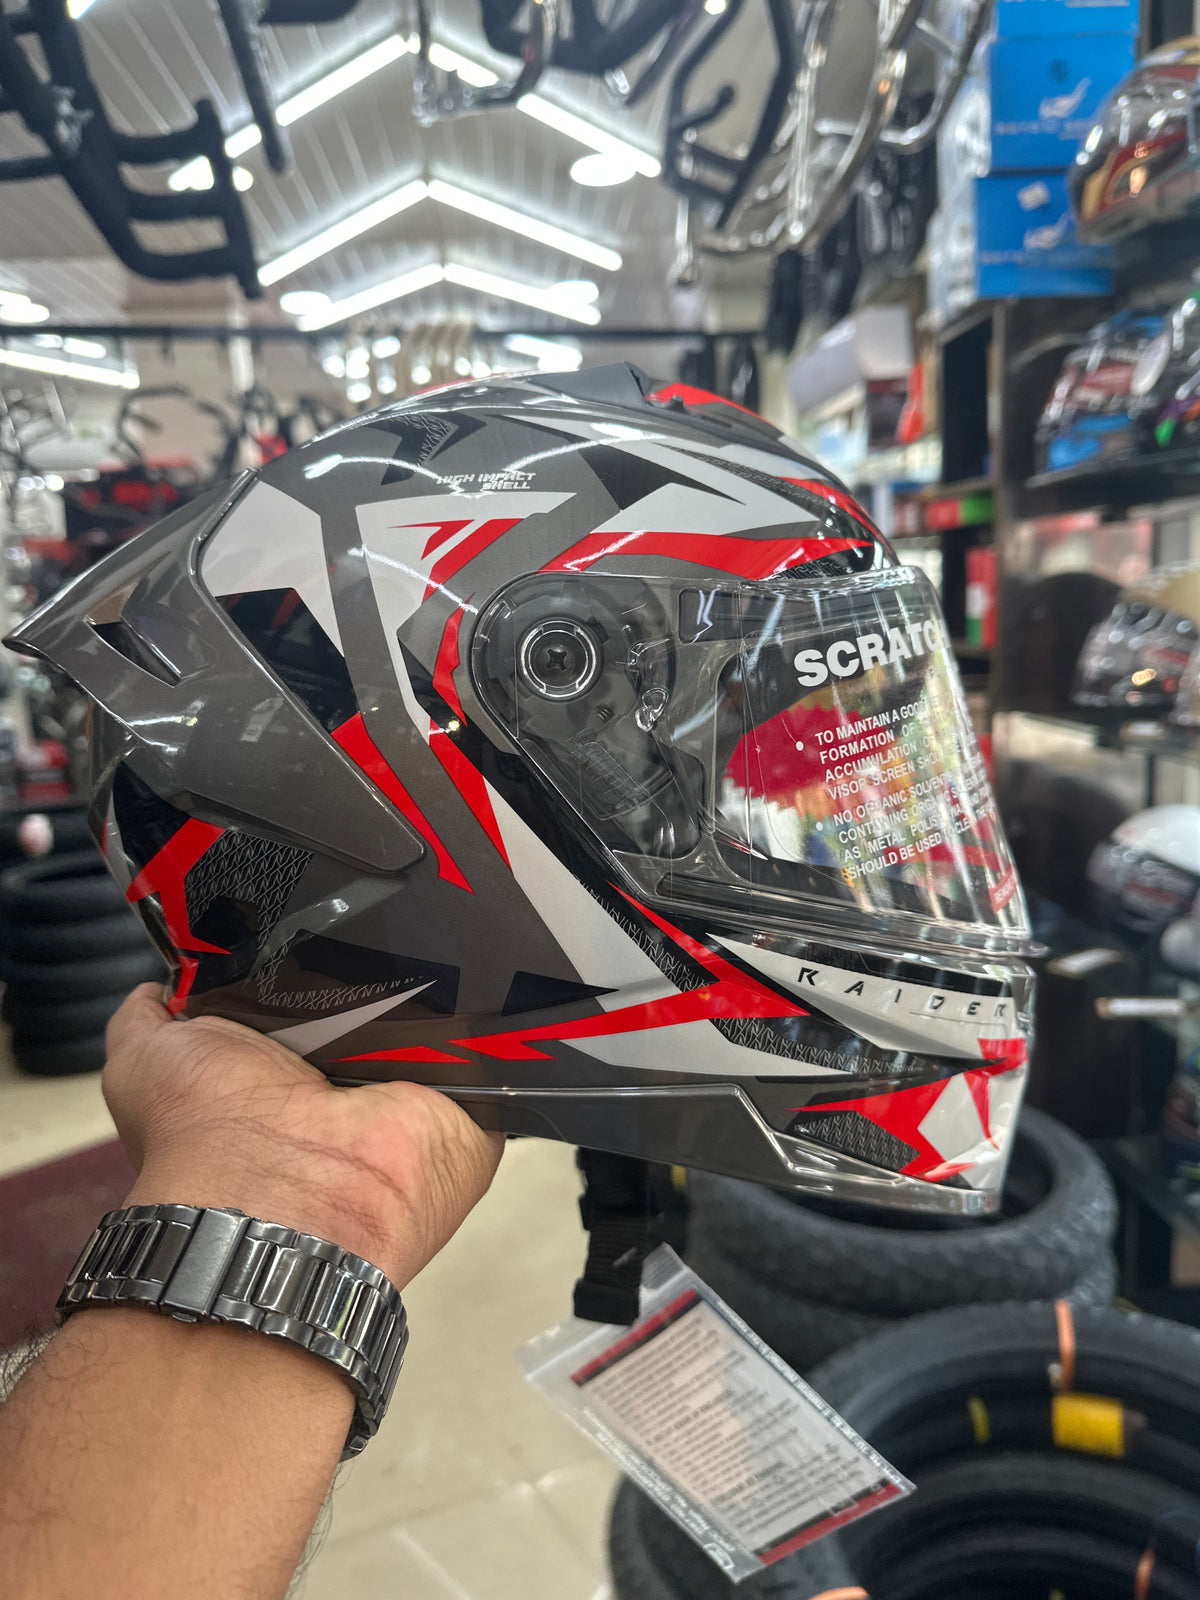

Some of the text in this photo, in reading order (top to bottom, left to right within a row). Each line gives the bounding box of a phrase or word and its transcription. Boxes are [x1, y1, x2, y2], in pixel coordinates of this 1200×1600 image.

[436, 471, 537, 485] HIGH IMPACT
[482, 481, 531, 491] SHELL
[814, 729, 835, 746] TO
[835, 711, 891, 740] MAINTAIN
[892, 709, 900, 723] A
[819, 729, 895, 765] FORMATION
[901, 721, 915, 737] OF
[825, 741, 918, 783] ACCUMULATION
[828, 776, 868, 800] VISOR
[872, 760, 916, 786] SCREEN
[833, 809, 853, 827] NO
[838, 808, 909, 844] CONTAINING
[844, 845, 862, 863] AS
[867, 830, 907, 854] METAL
[910, 812, 943, 837] POLIS
[847, 851, 899, 880] SHOULD
[898, 843, 916, 861] BE
[915, 831, 942, 853] USED
[954, 812, 975, 834] CLE
